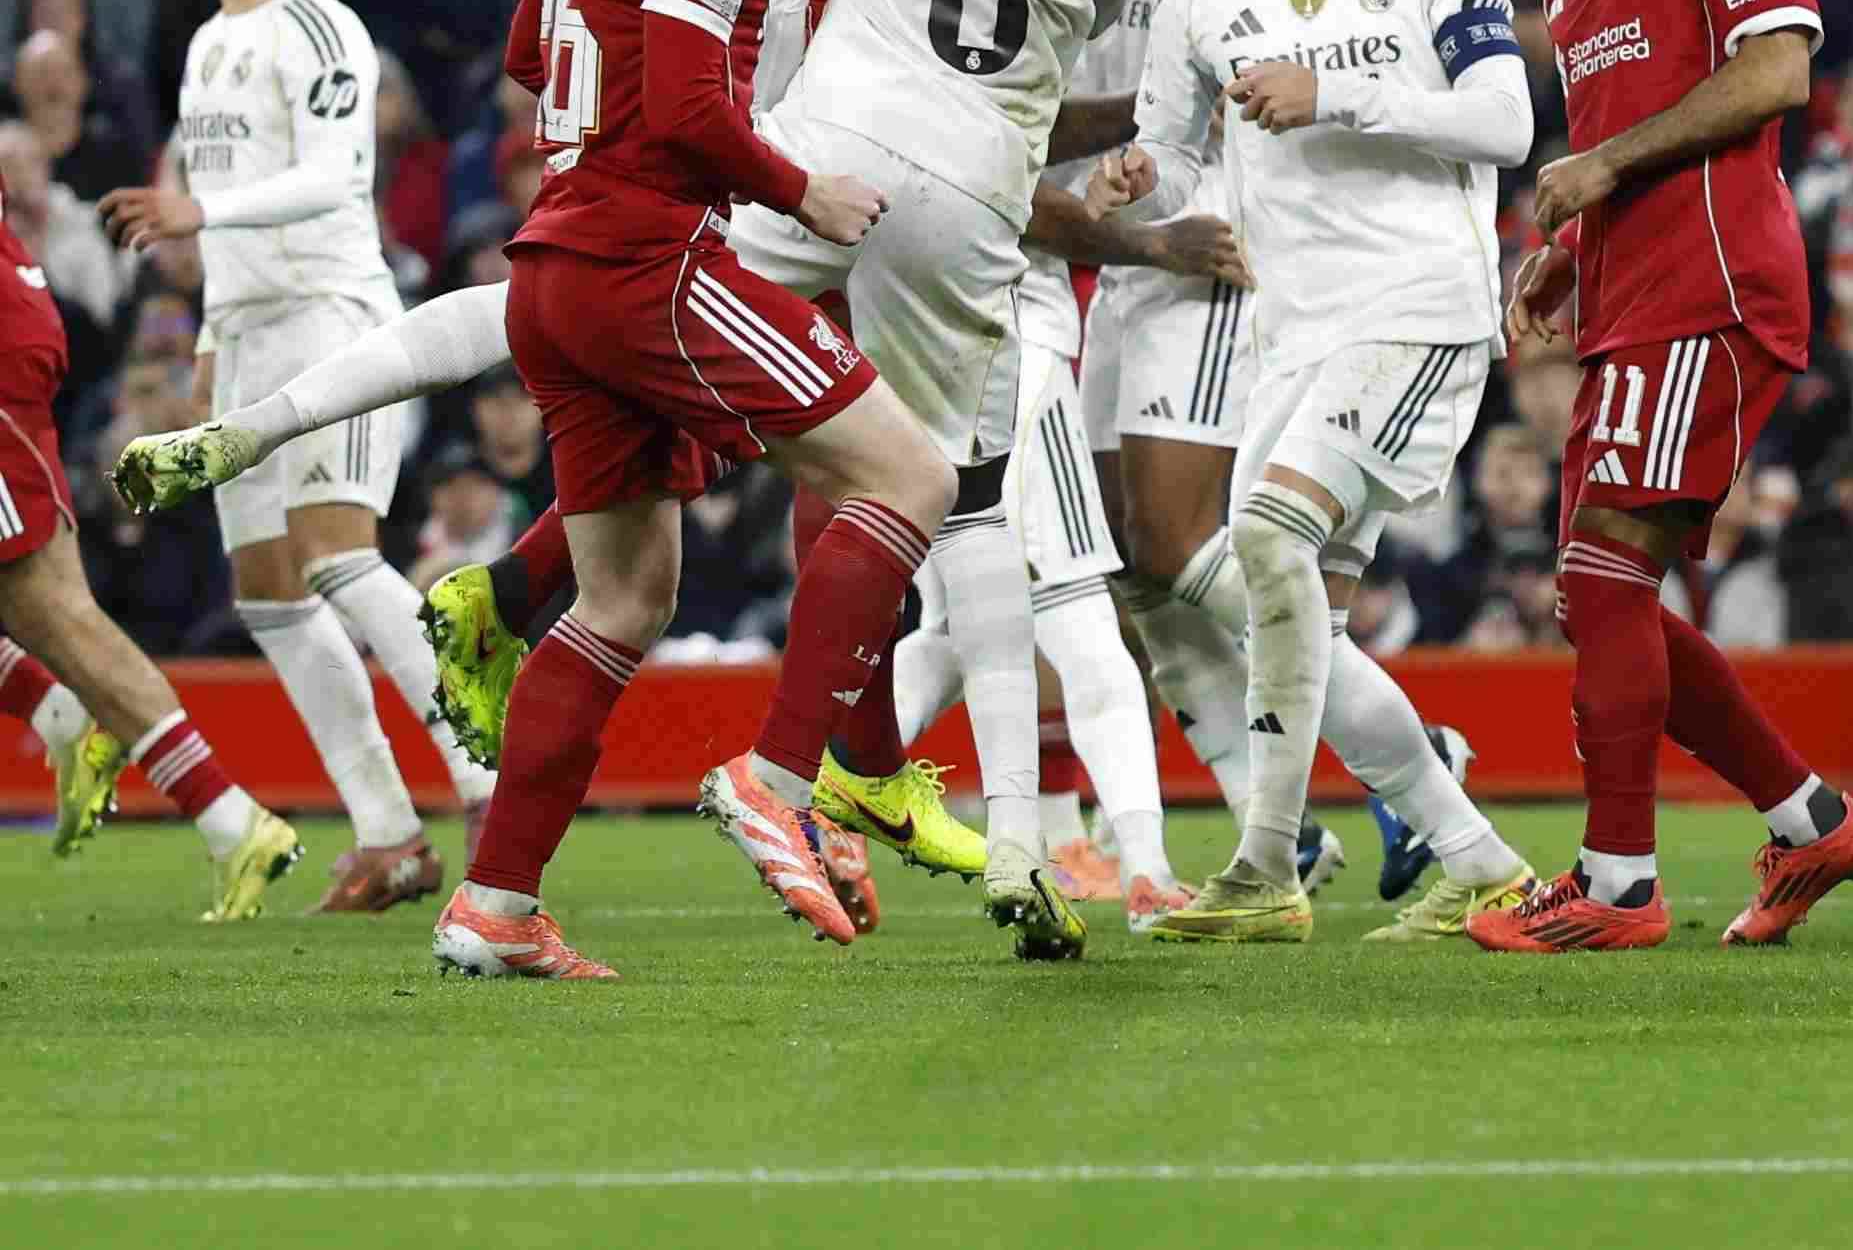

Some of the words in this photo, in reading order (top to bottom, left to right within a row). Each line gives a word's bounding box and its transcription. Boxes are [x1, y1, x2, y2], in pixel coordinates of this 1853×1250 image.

[1570, 38, 1650, 84] chartered
[309, 68, 359, 119] hp
[1592, 363, 1647, 446] 11
